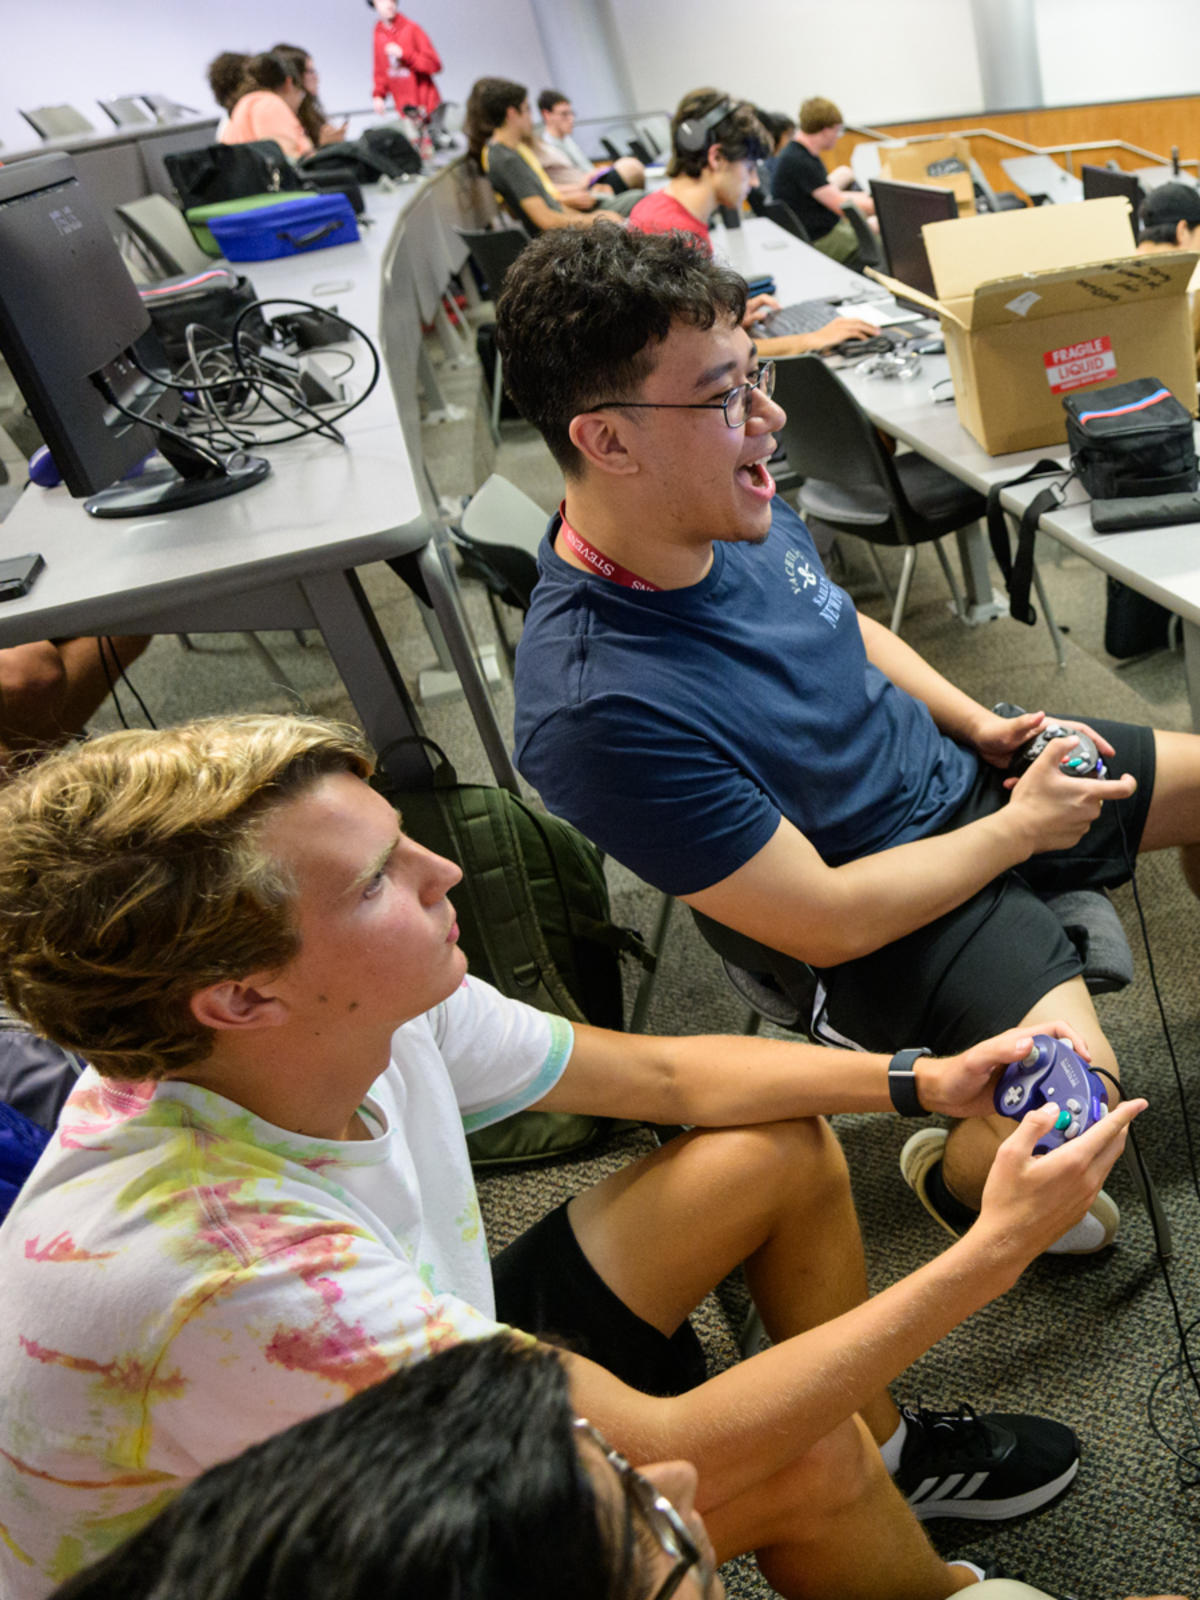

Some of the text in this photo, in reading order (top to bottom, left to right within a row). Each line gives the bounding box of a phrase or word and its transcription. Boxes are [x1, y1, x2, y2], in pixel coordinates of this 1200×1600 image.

[1052, 338, 1103, 364] FRAGILE
[1058, 357, 1105, 380] LIQUID
[567, 530, 615, 576] STEVENS
